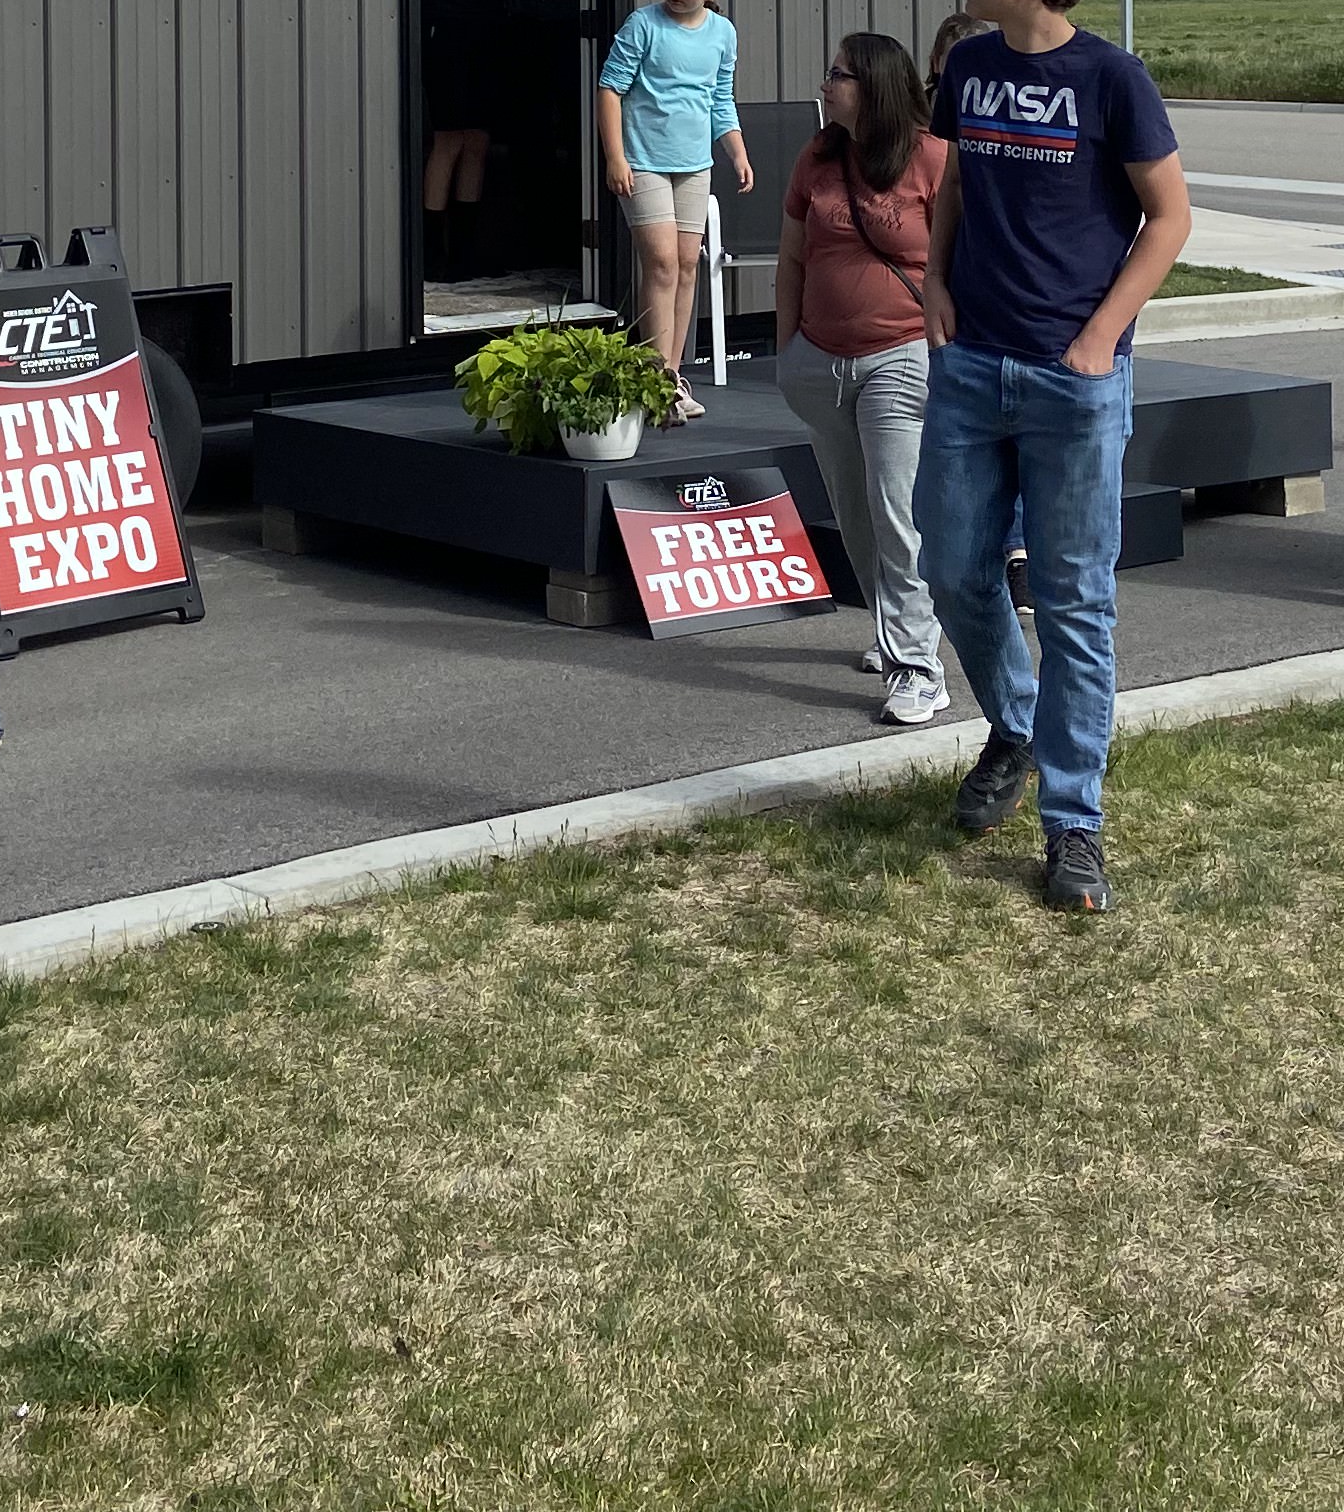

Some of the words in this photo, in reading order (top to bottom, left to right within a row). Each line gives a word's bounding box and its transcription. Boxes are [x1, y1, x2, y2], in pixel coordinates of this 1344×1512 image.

[961, 76, 1079, 127] NASA
[1003, 144, 1075, 164] SCIENTIST
[20, 353, 99, 368] CONSTRUCTION
[21, 360, 100, 375] MANAGEMENT
[685, 486, 721, 503] CTE
[9, 515, 159, 594] EXPO
[650, 514, 785, 567] FREE
[646, 555, 816, 613] TOURS
